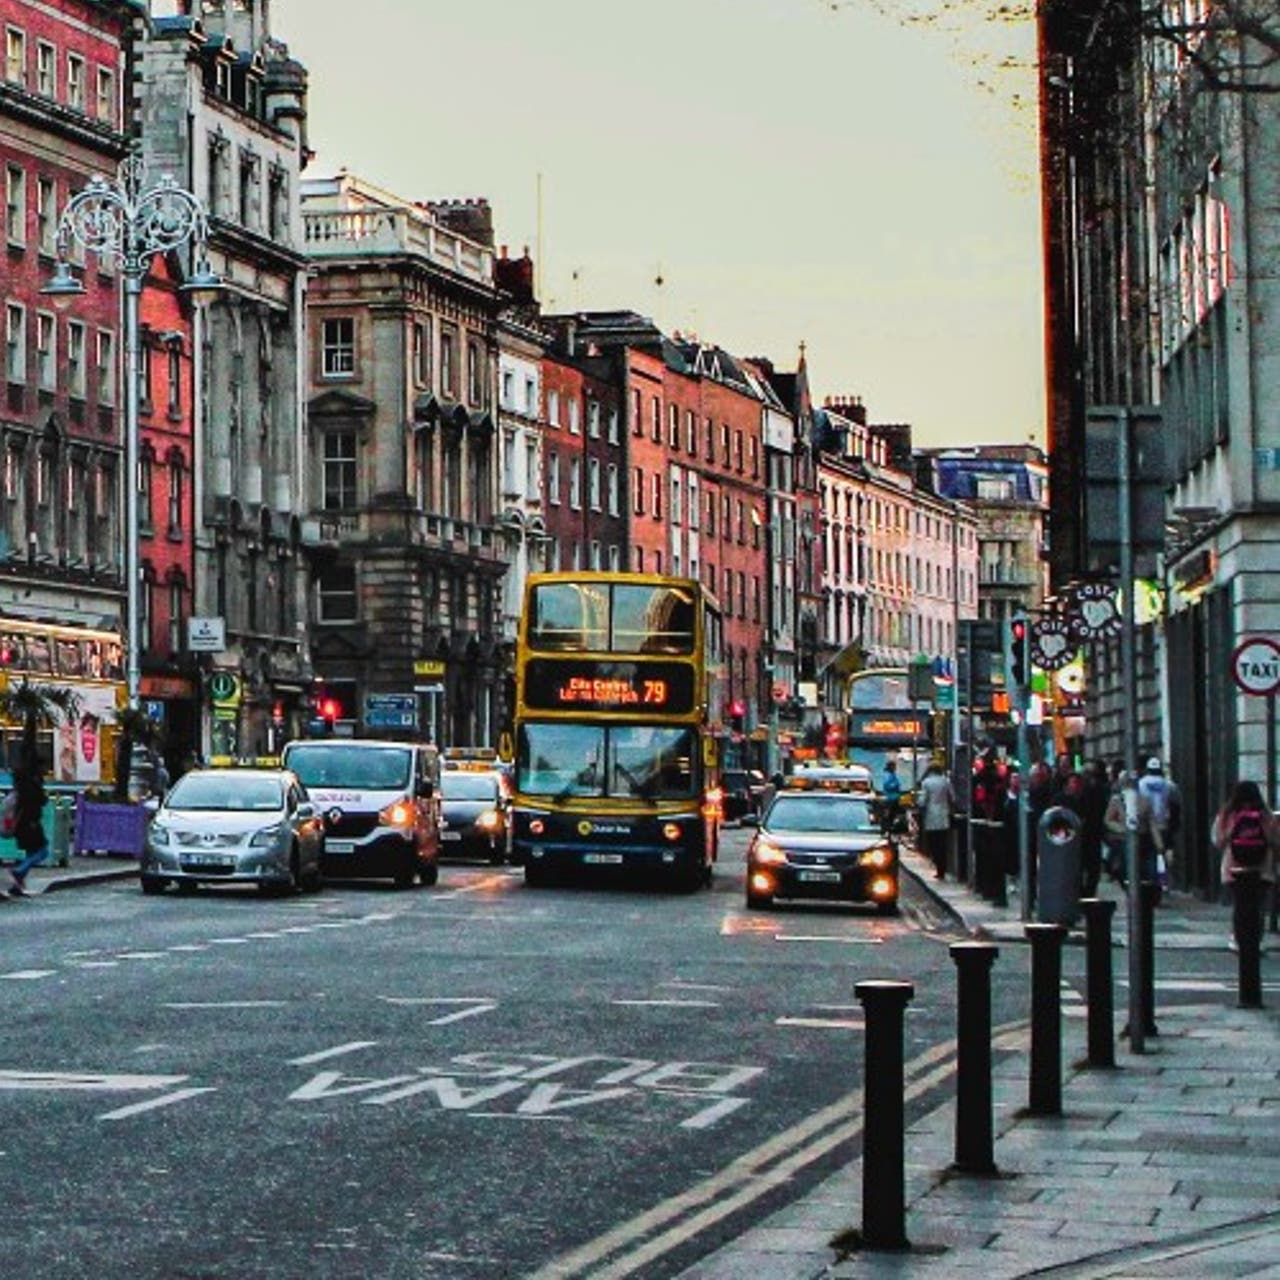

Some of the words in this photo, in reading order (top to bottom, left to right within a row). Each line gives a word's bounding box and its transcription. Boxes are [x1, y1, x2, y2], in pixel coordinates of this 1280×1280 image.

[1077, 584, 1117, 600] COSTA
[1034, 621, 1069, 635] COSTA
[1072, 618, 1123, 639] COFFEE
[1031, 651, 1074, 669] COFFEE
[1240, 662, 1278, 677] TAXI
[643, 680, 665, 702] 79
[417, 1052, 767, 1093] BUS
